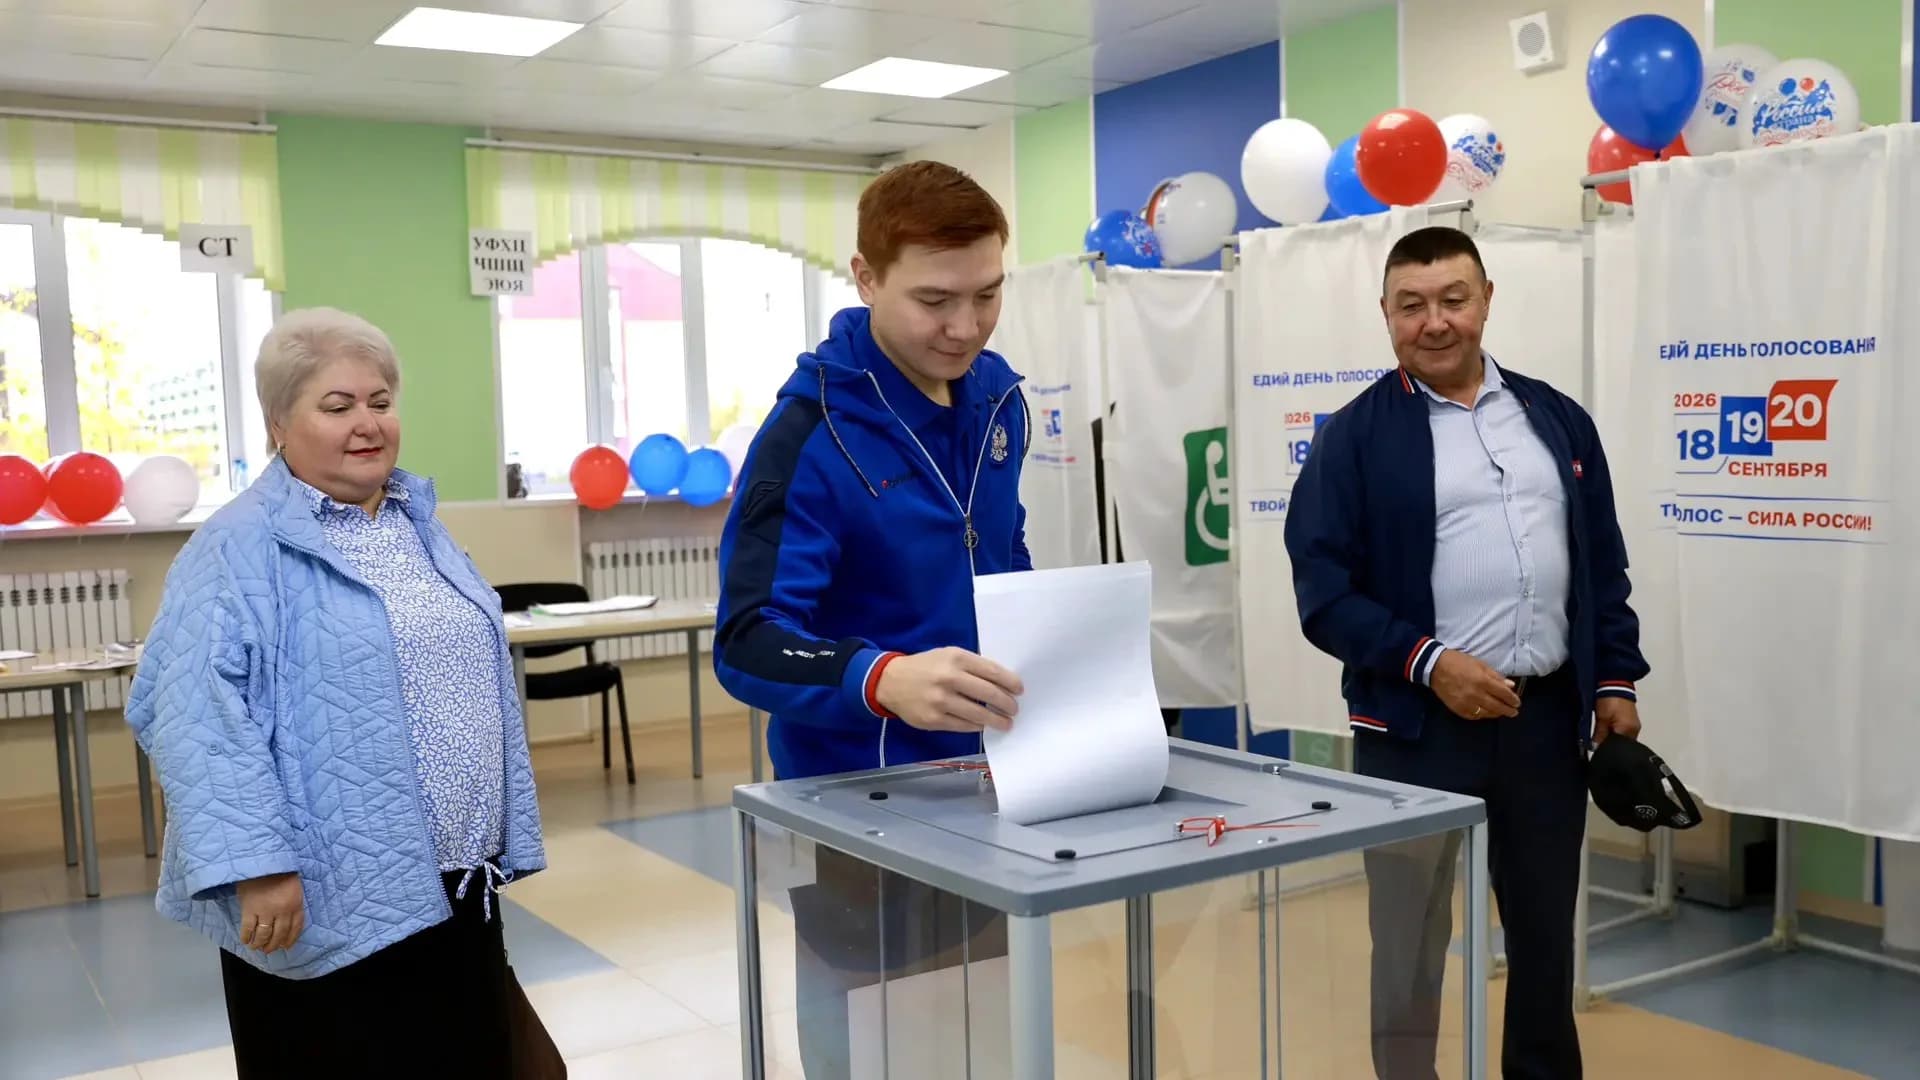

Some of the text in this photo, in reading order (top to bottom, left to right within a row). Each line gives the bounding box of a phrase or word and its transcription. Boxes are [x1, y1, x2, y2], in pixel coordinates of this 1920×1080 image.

[199, 236, 238, 257] СТ
[1694, 343, 1747, 360] ДЕНЬ
[1294, 373, 1333, 387] ДЕНЬ
[1674, 393, 1717, 408] 2026
[1677, 393, 1823, 461] 18 19 20
[1728, 461, 1828, 477] СЕНТЯБРЯ
[1250, 497, 1286, 512] ТВОЙ
[1747, 511, 1797, 528] СИЛА
